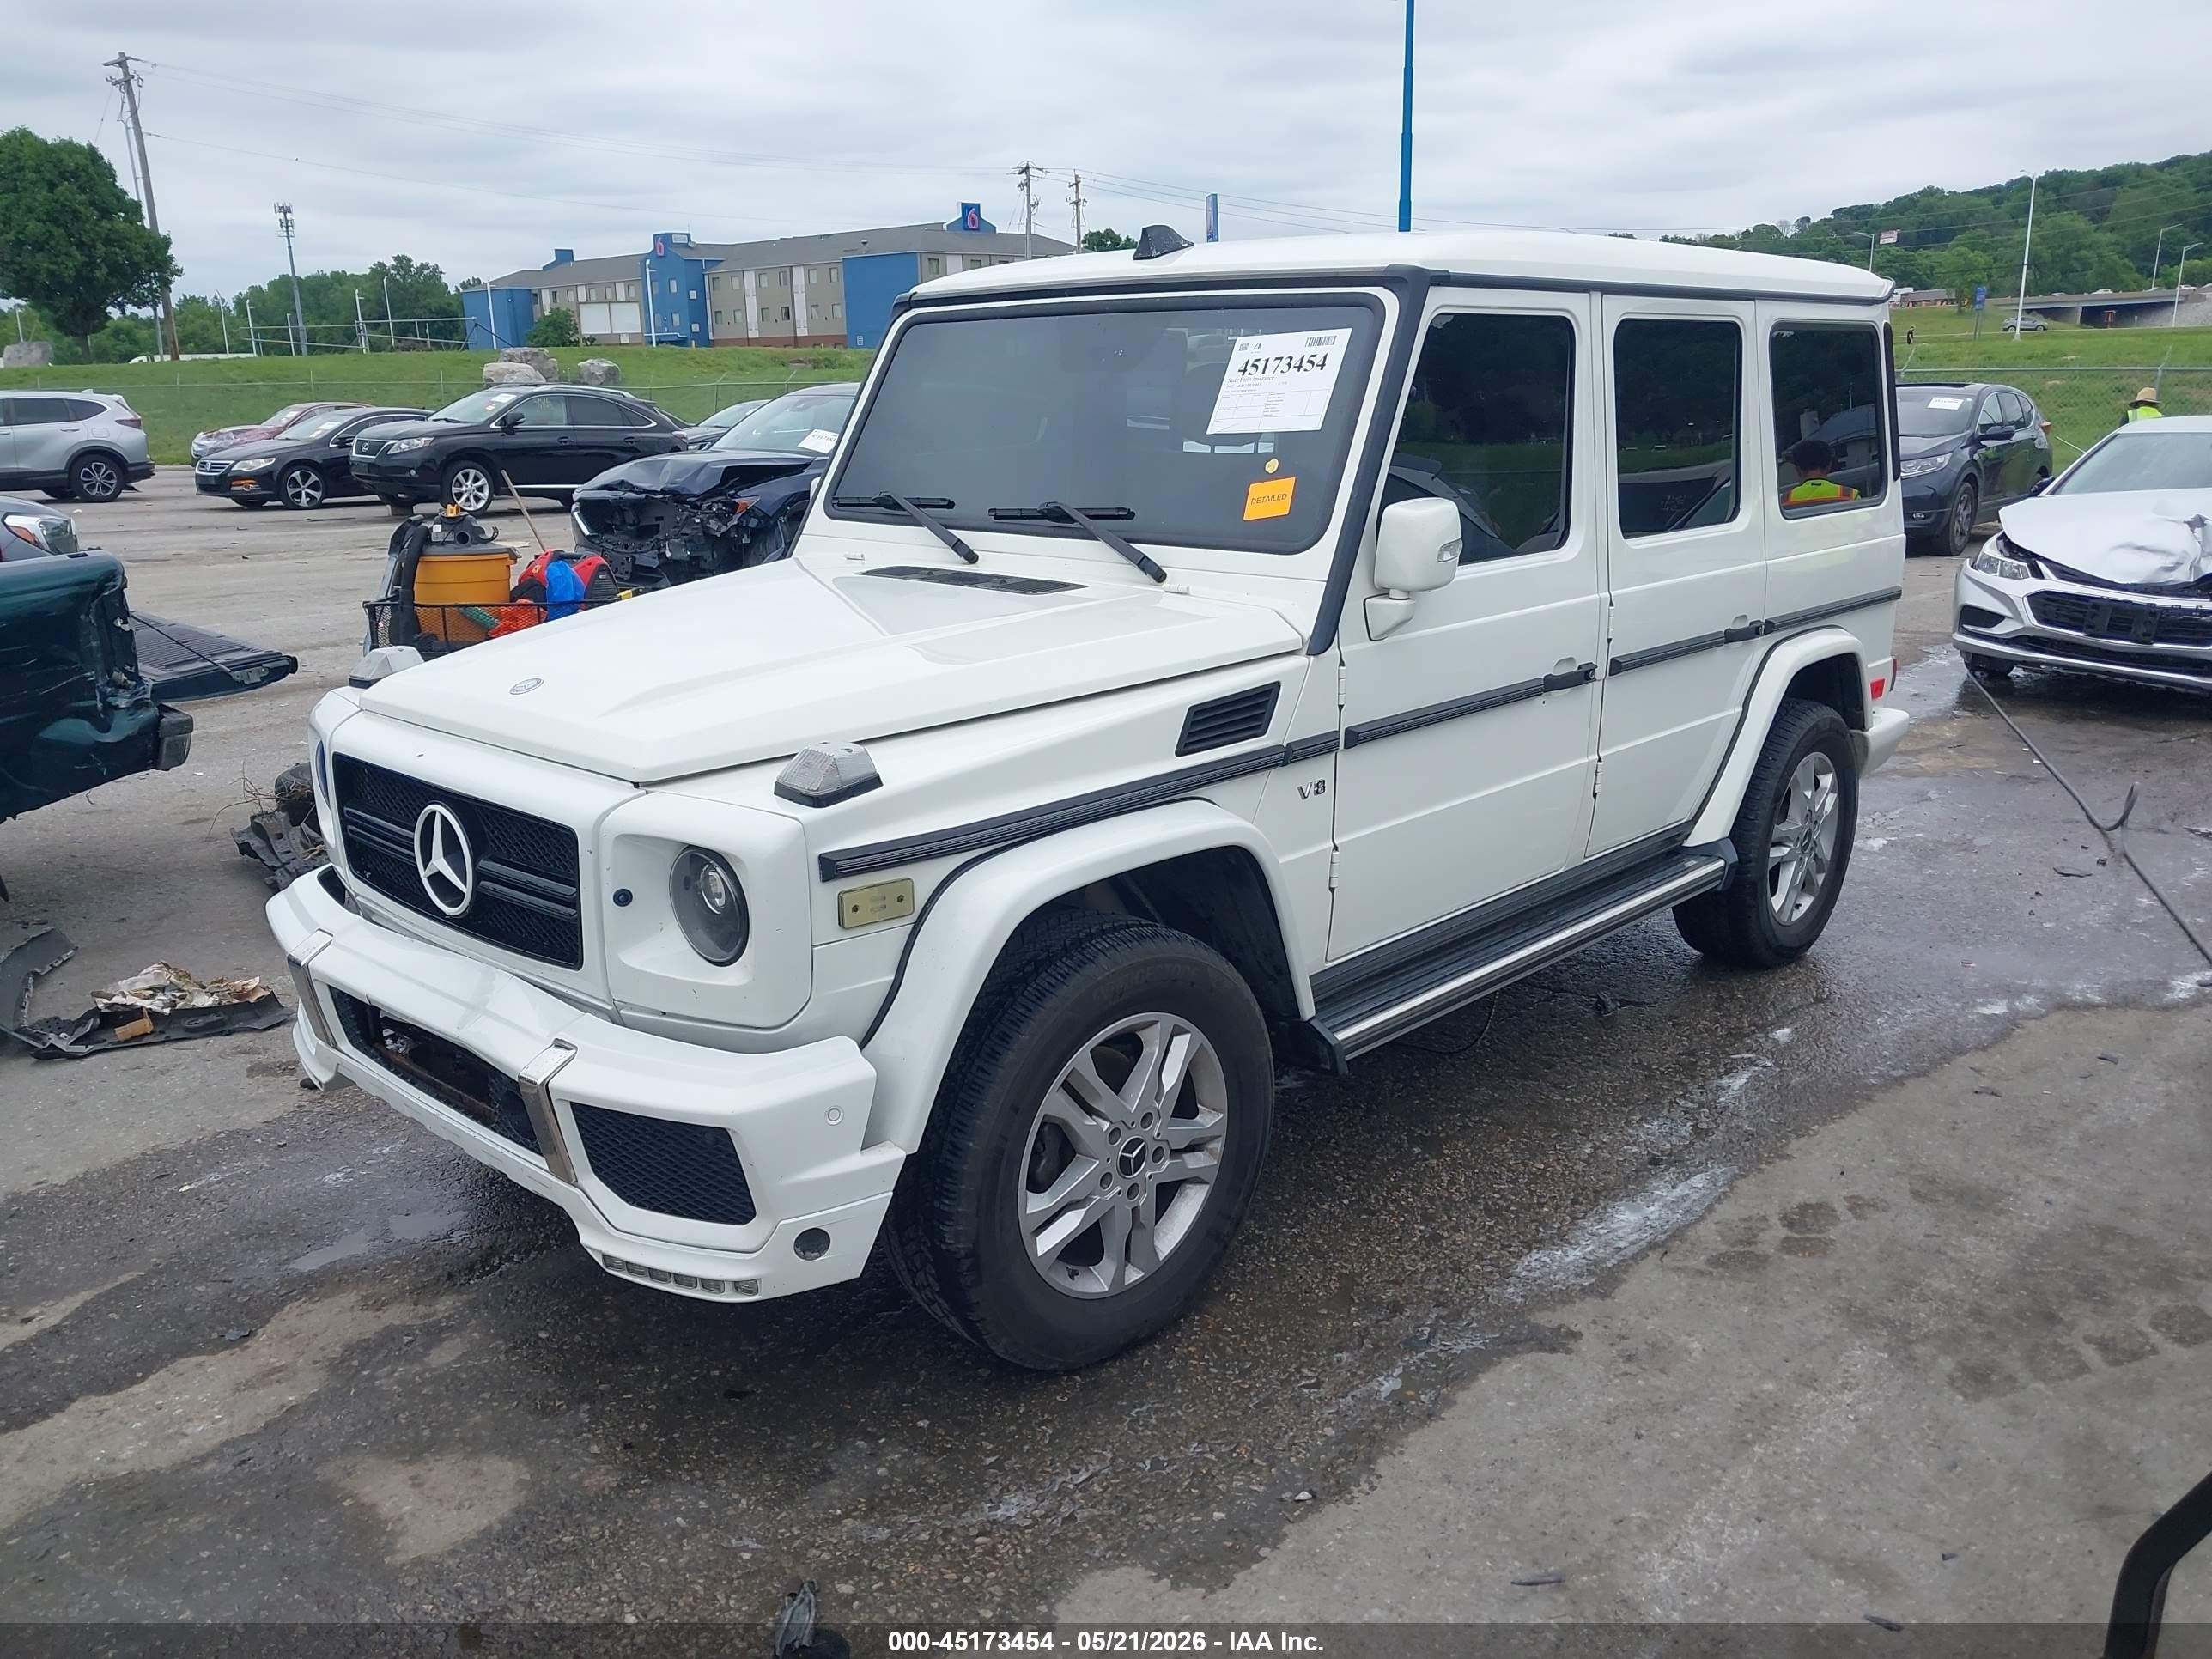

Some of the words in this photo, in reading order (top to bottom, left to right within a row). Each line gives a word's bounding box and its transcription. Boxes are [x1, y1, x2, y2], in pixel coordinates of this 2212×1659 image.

[967, 207, 979, 229] 6
[655, 236, 665, 256] 6
[1237, 353, 1328, 376] 45173454
[1250, 492, 1287, 505] DETAILED
[1297, 779, 1326, 800] V8
